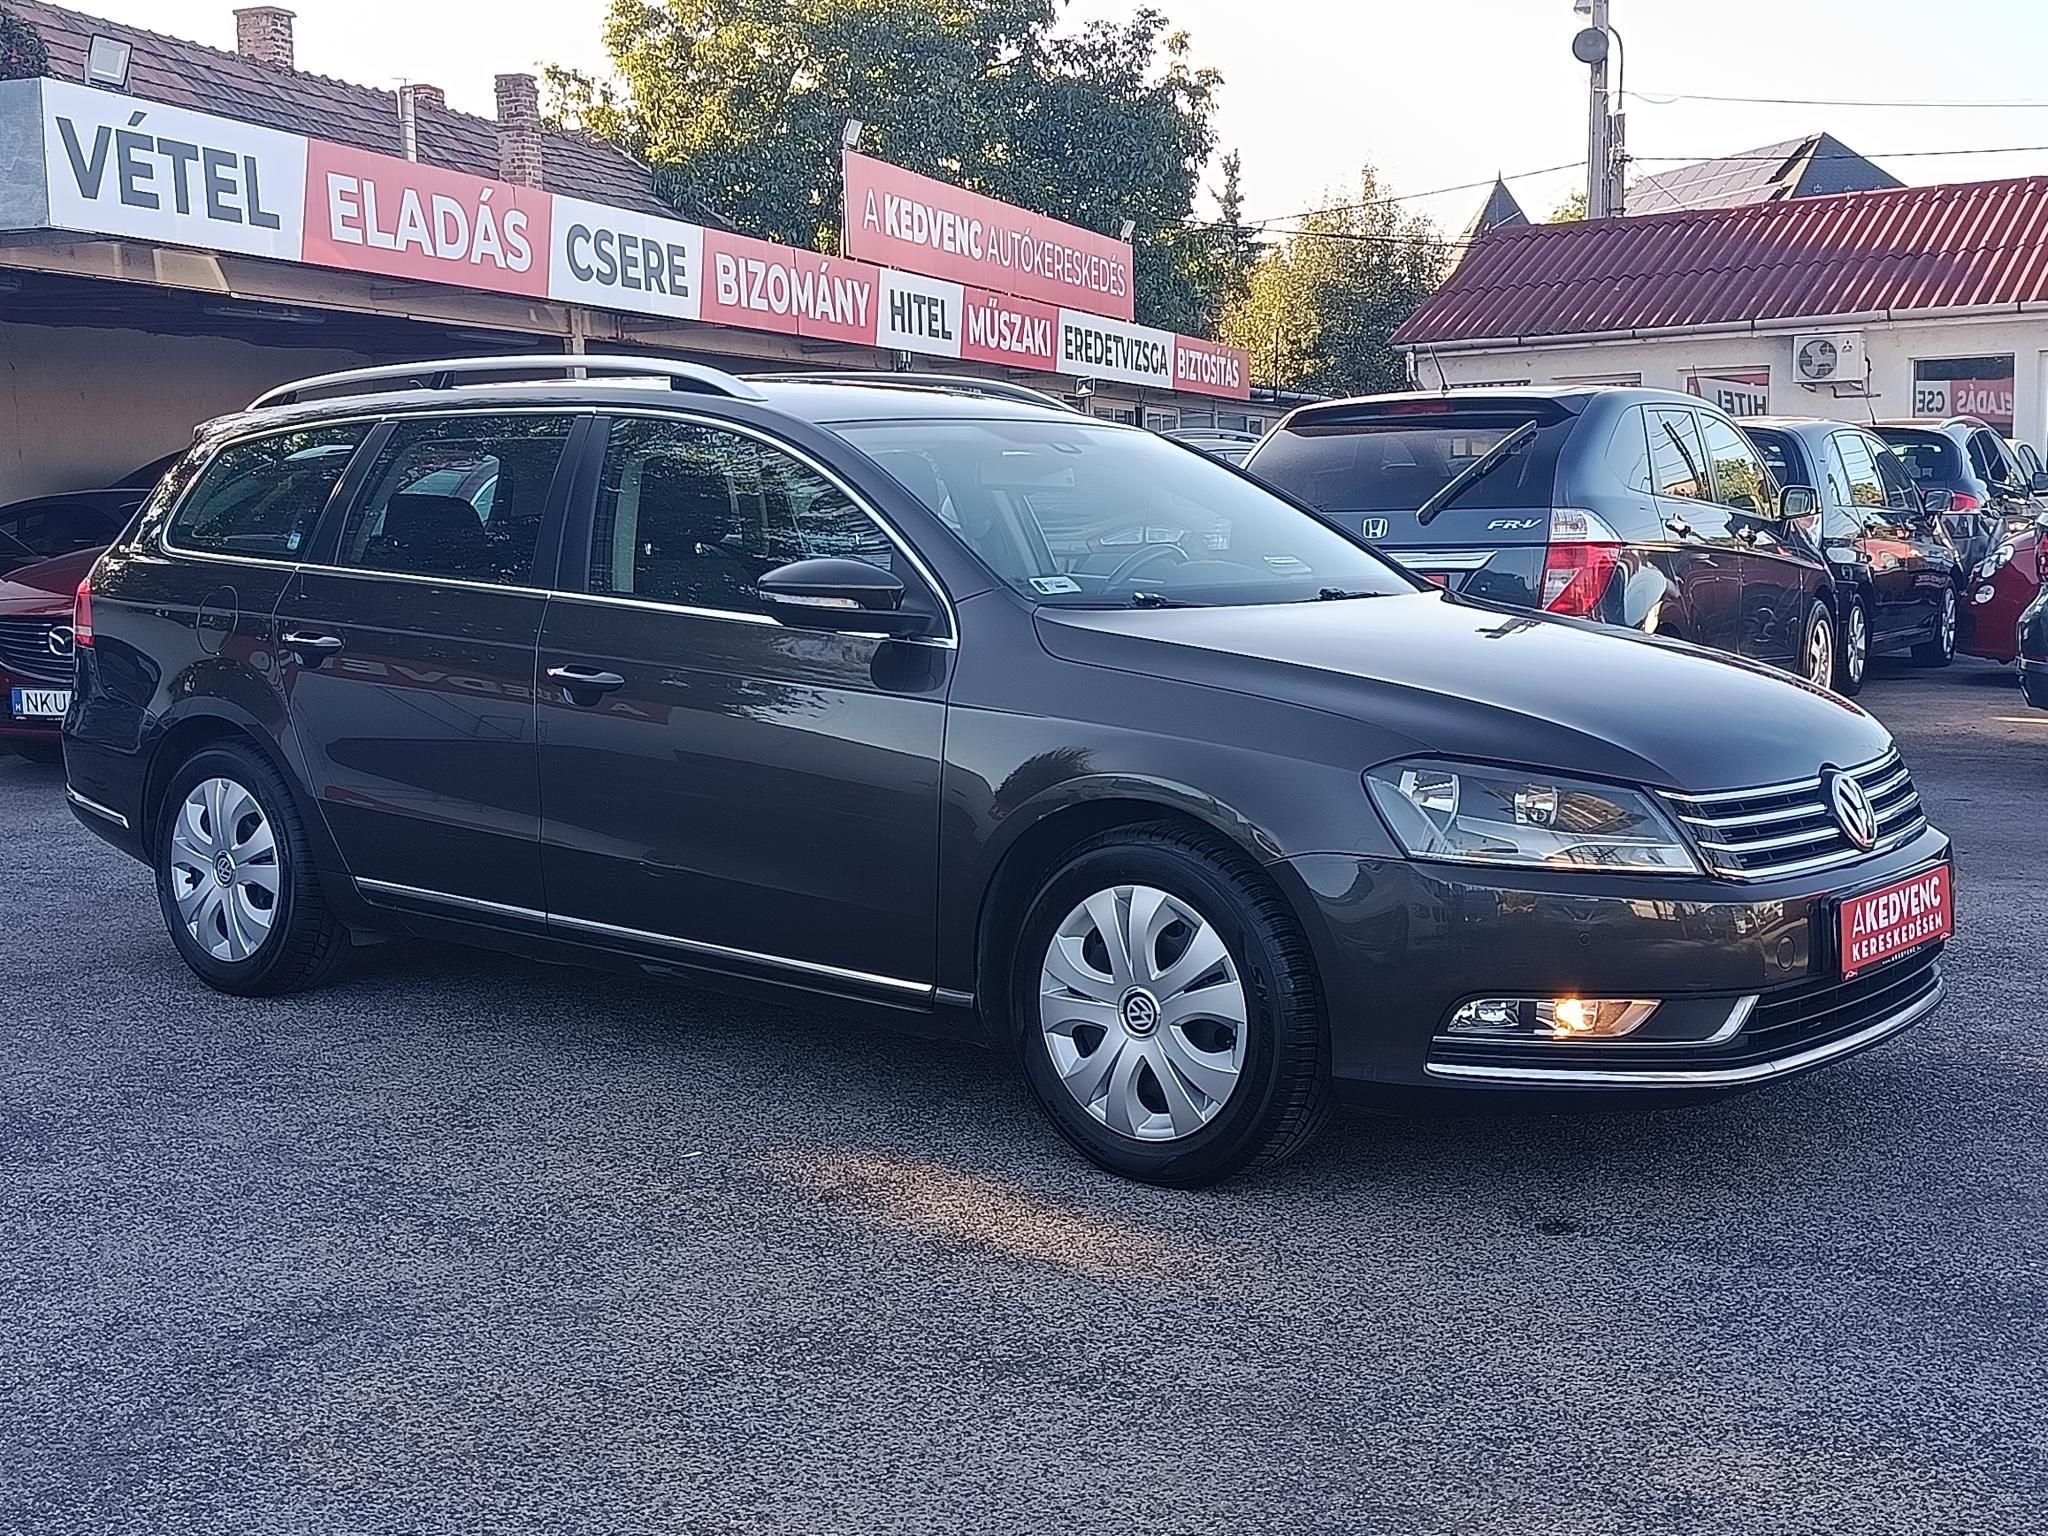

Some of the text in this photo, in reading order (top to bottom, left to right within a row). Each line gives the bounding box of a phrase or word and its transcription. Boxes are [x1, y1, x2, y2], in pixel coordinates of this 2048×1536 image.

[56, 111, 1240, 388] VÉTEL ELADÁS CSERE BIZOMÁNY HITEL MŰSZAKI EREDETVIZSGA BIZTOSÍTÁS
[864, 188, 1126, 297] A KEDVENC AUTÓKERESKEDÉS
[1487, 518, 1543, 530] FR-V
[1852, 911, 1943, 962] KERESKEDÉSEM
